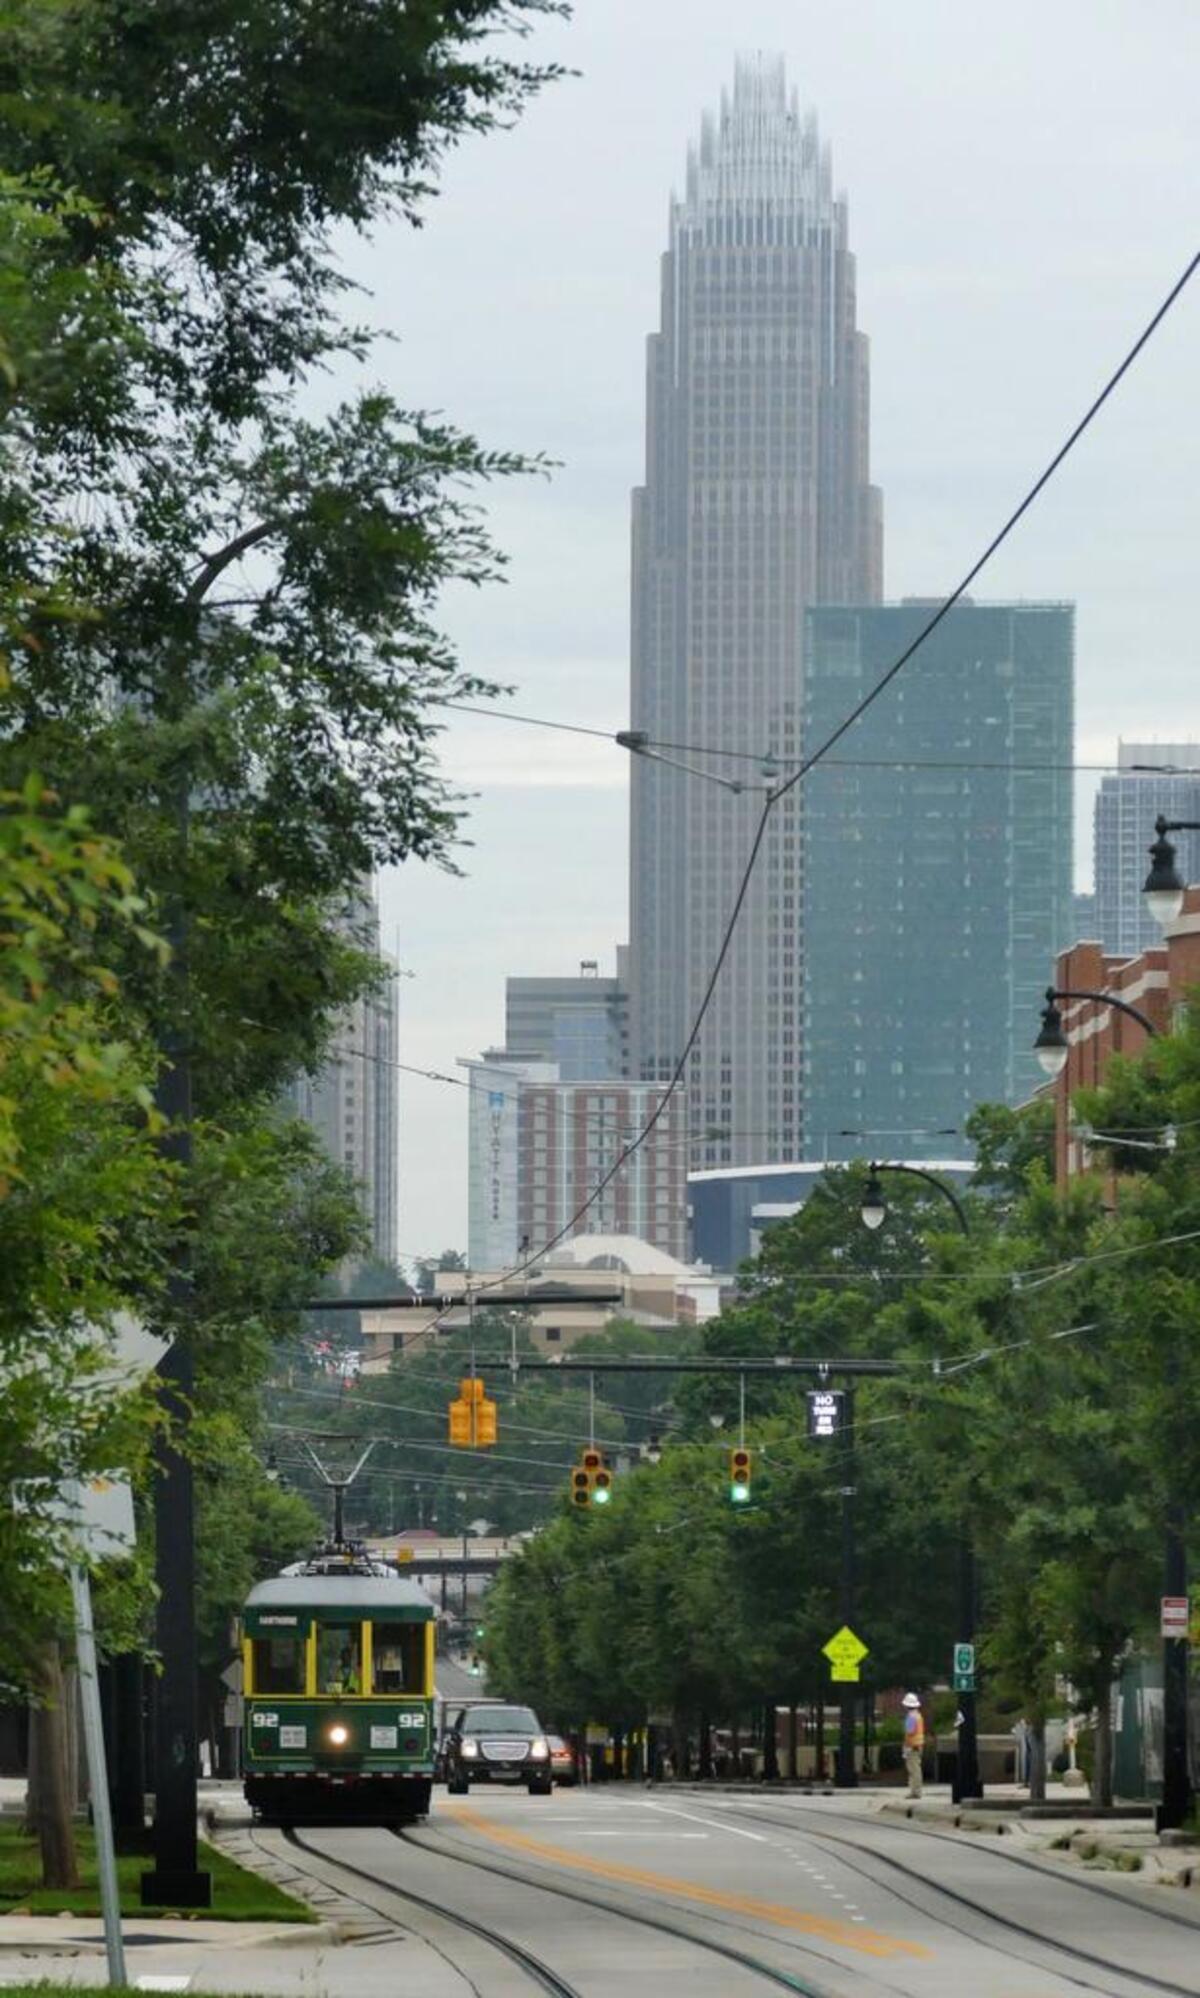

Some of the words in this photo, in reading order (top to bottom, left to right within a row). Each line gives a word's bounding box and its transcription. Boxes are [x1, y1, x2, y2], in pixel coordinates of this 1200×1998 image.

[815, 1395, 834, 1406] NO
[253, 1713, 279, 1727] 92
[398, 1713, 426, 1728] 92
